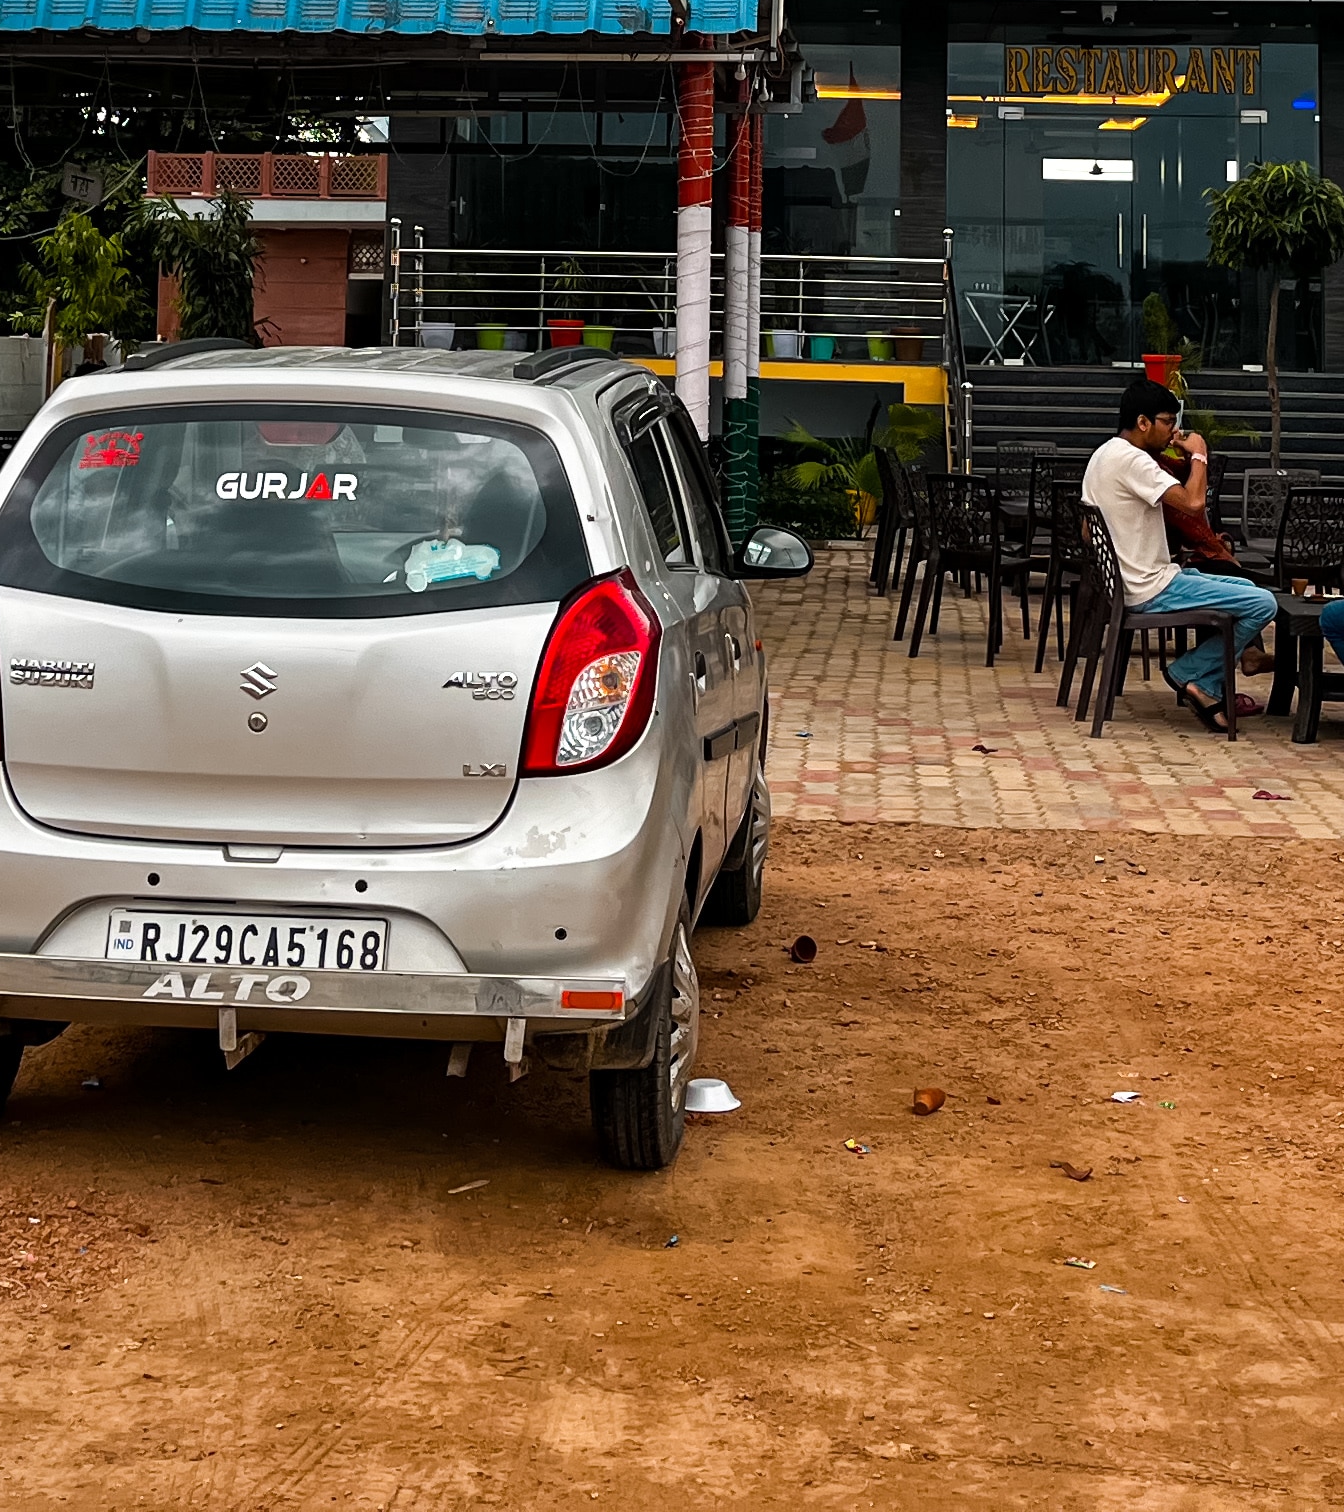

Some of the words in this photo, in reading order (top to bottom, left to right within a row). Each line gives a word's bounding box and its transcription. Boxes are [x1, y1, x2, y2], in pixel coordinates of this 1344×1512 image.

[1005, 45, 1261, 96] RESTAURANT
[215, 471, 358, 501] GURJAR
[10, 658, 95, 673] MARUTI
[10, 670, 94, 689] SUZUKI
[442, 671, 518, 688] ALTO
[472, 688, 516, 700] 800
[113, 938, 134, 950] IND
[140, 921, 381, 971] RJ29CA5168
[142, 971, 311, 1003] ALTO
